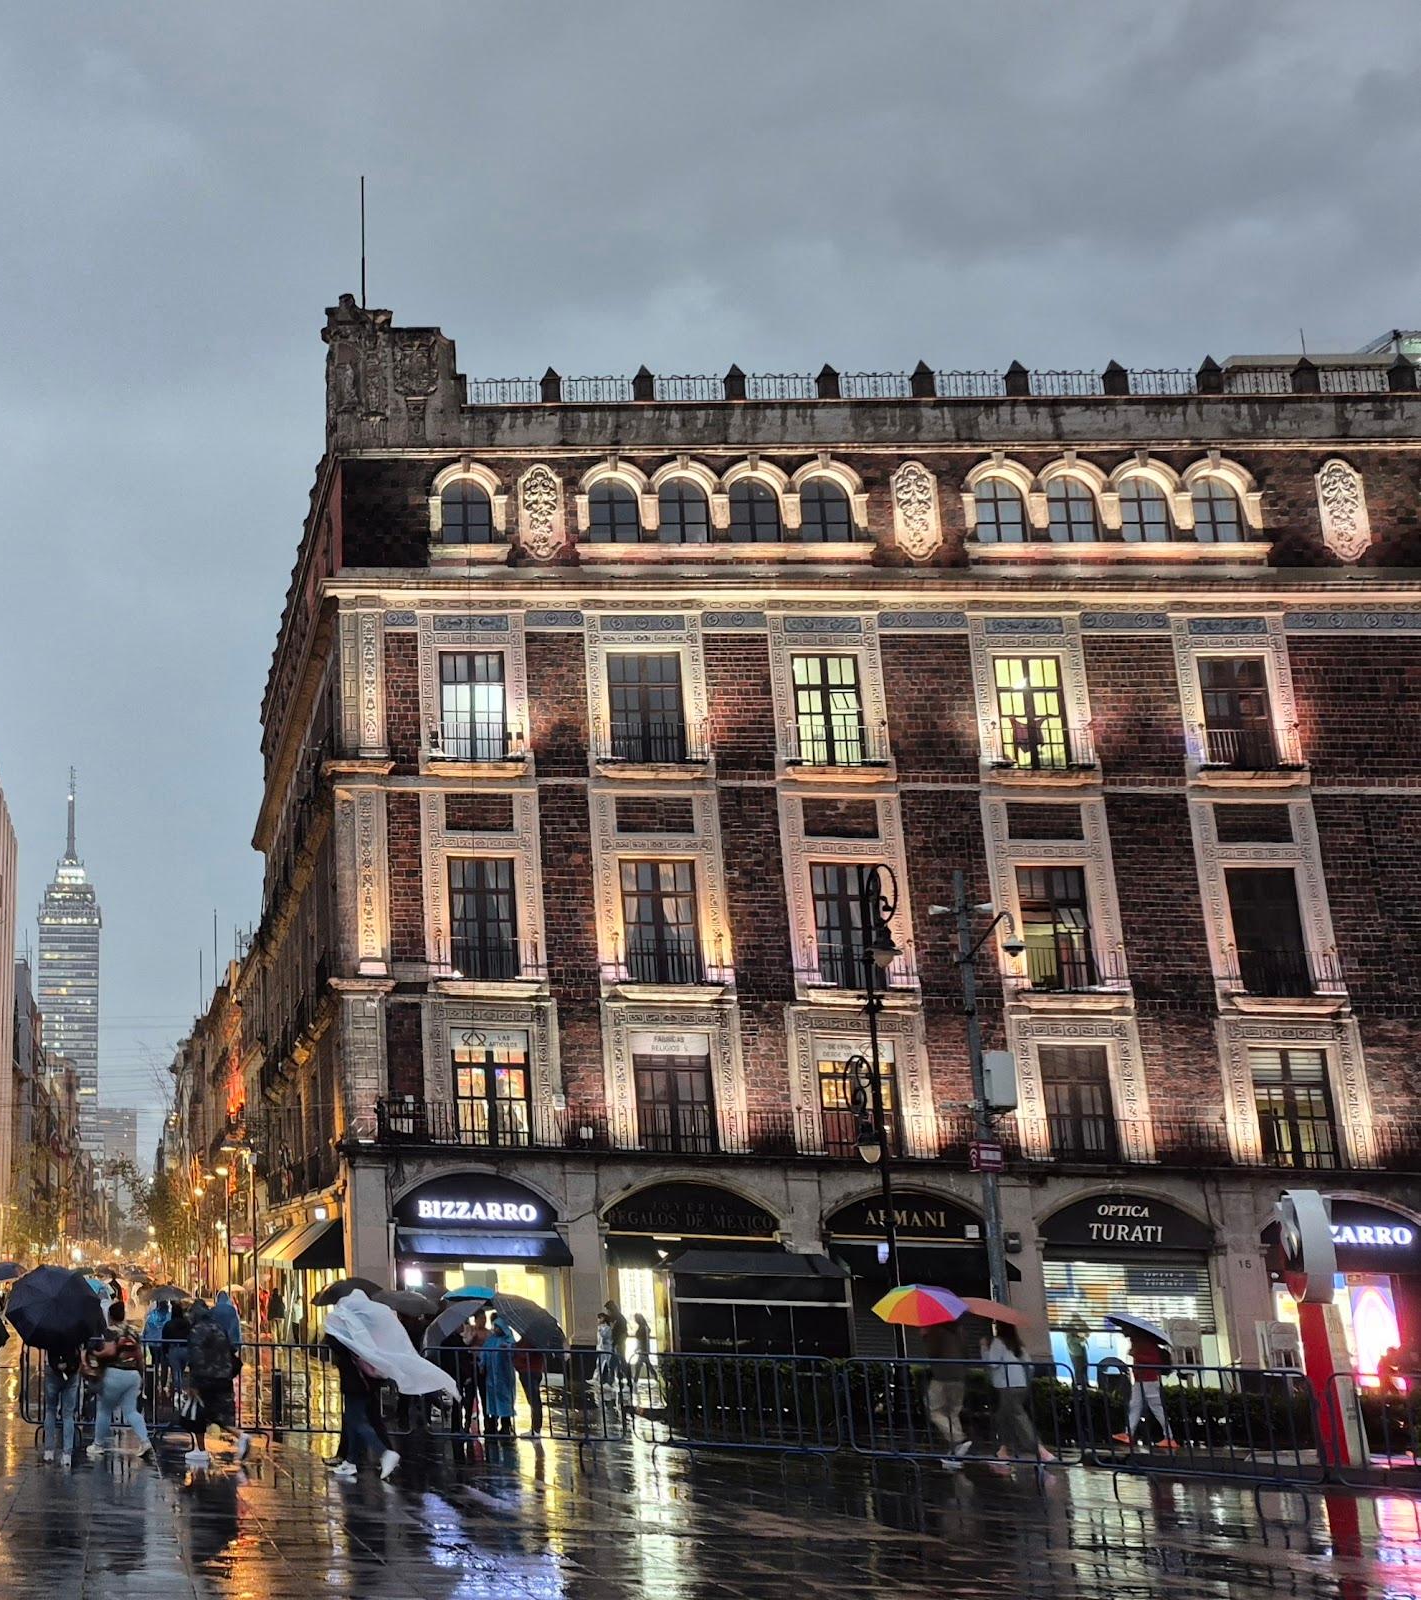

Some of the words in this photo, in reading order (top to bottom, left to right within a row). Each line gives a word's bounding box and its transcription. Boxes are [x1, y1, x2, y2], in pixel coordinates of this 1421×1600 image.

[417, 1199, 538, 1222] BIZZARRO
[607, 1209, 678, 1227] REGALOS
[685, 1212, 706, 1229] DE
[714, 1213, 774, 1230] MEXICO
[1097, 1204, 1150, 1218] OPTICA
[1089, 1223, 1163, 1243] TURATI
[1329, 1225, 1413, 1245] ZARRO
